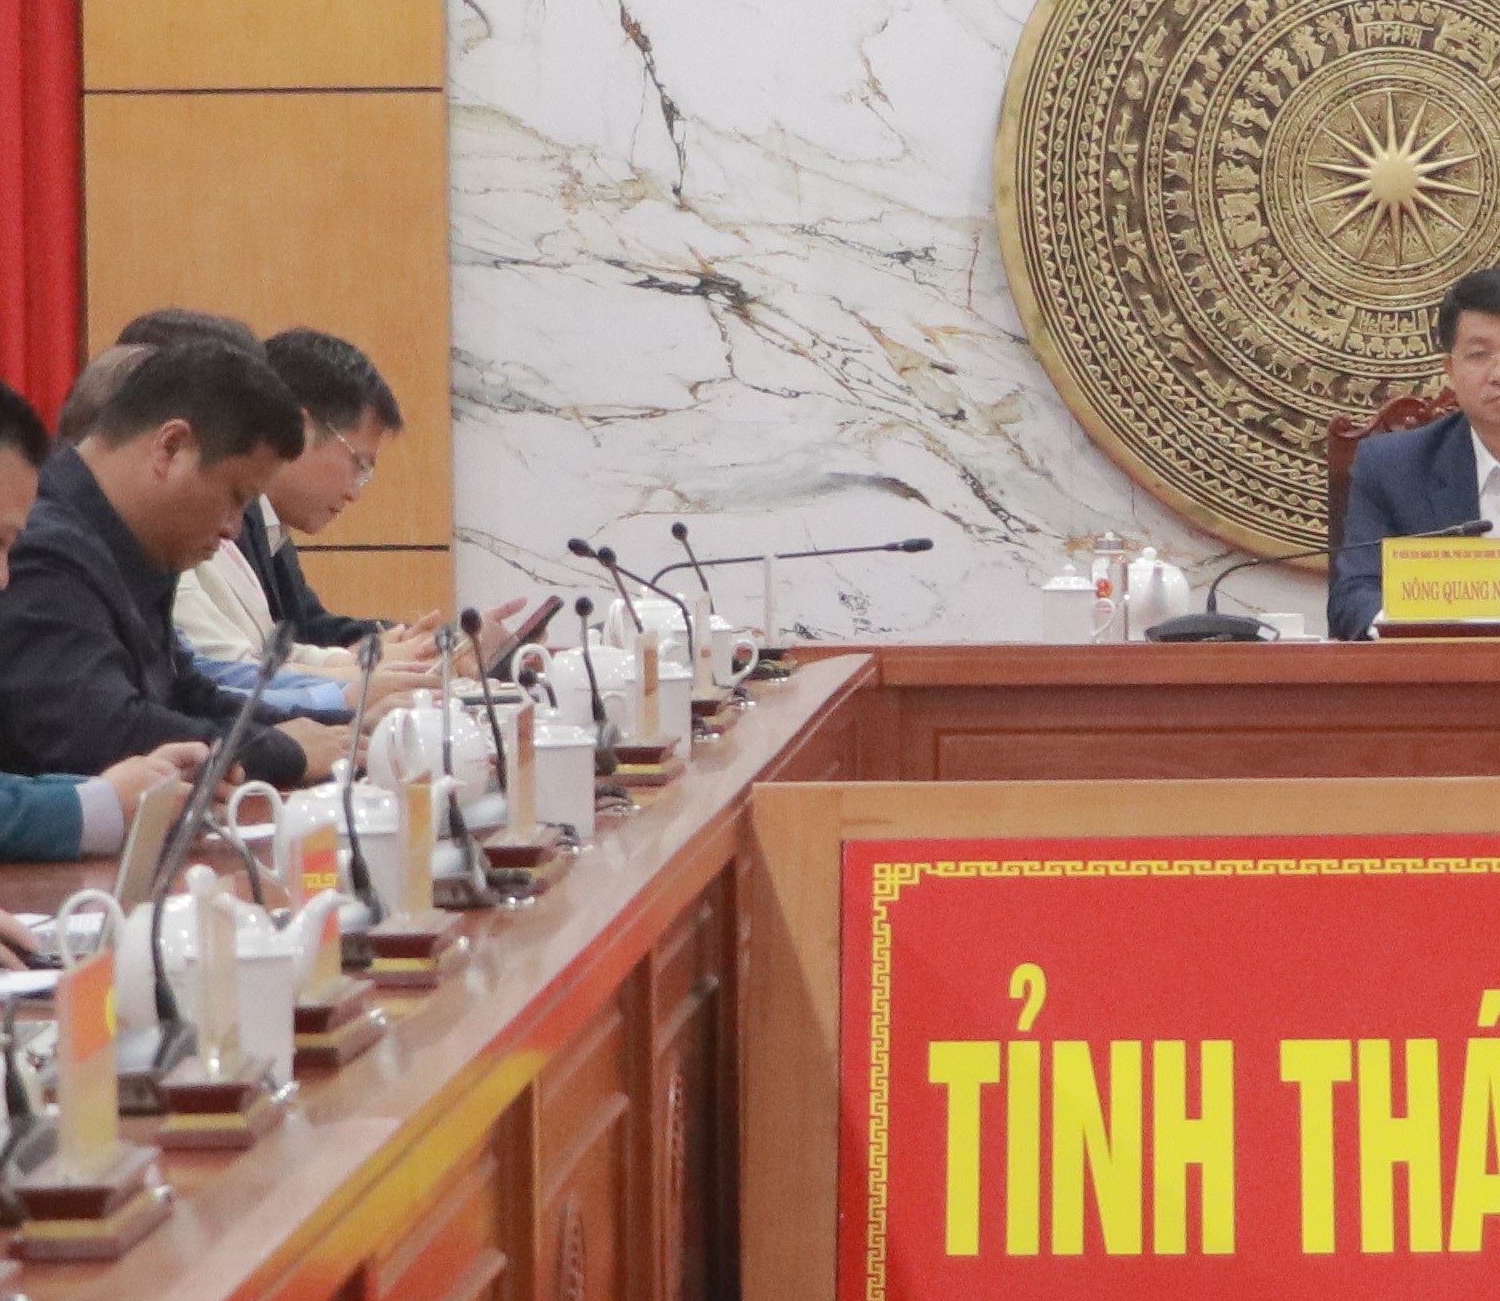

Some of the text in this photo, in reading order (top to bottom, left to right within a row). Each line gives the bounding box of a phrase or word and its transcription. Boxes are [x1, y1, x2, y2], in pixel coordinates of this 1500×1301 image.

[1402, 576, 1439, 600] NÔNG
[1443, 581, 1489, 604] QUANG
[928, 964, 1235, 1255] TỈNH
